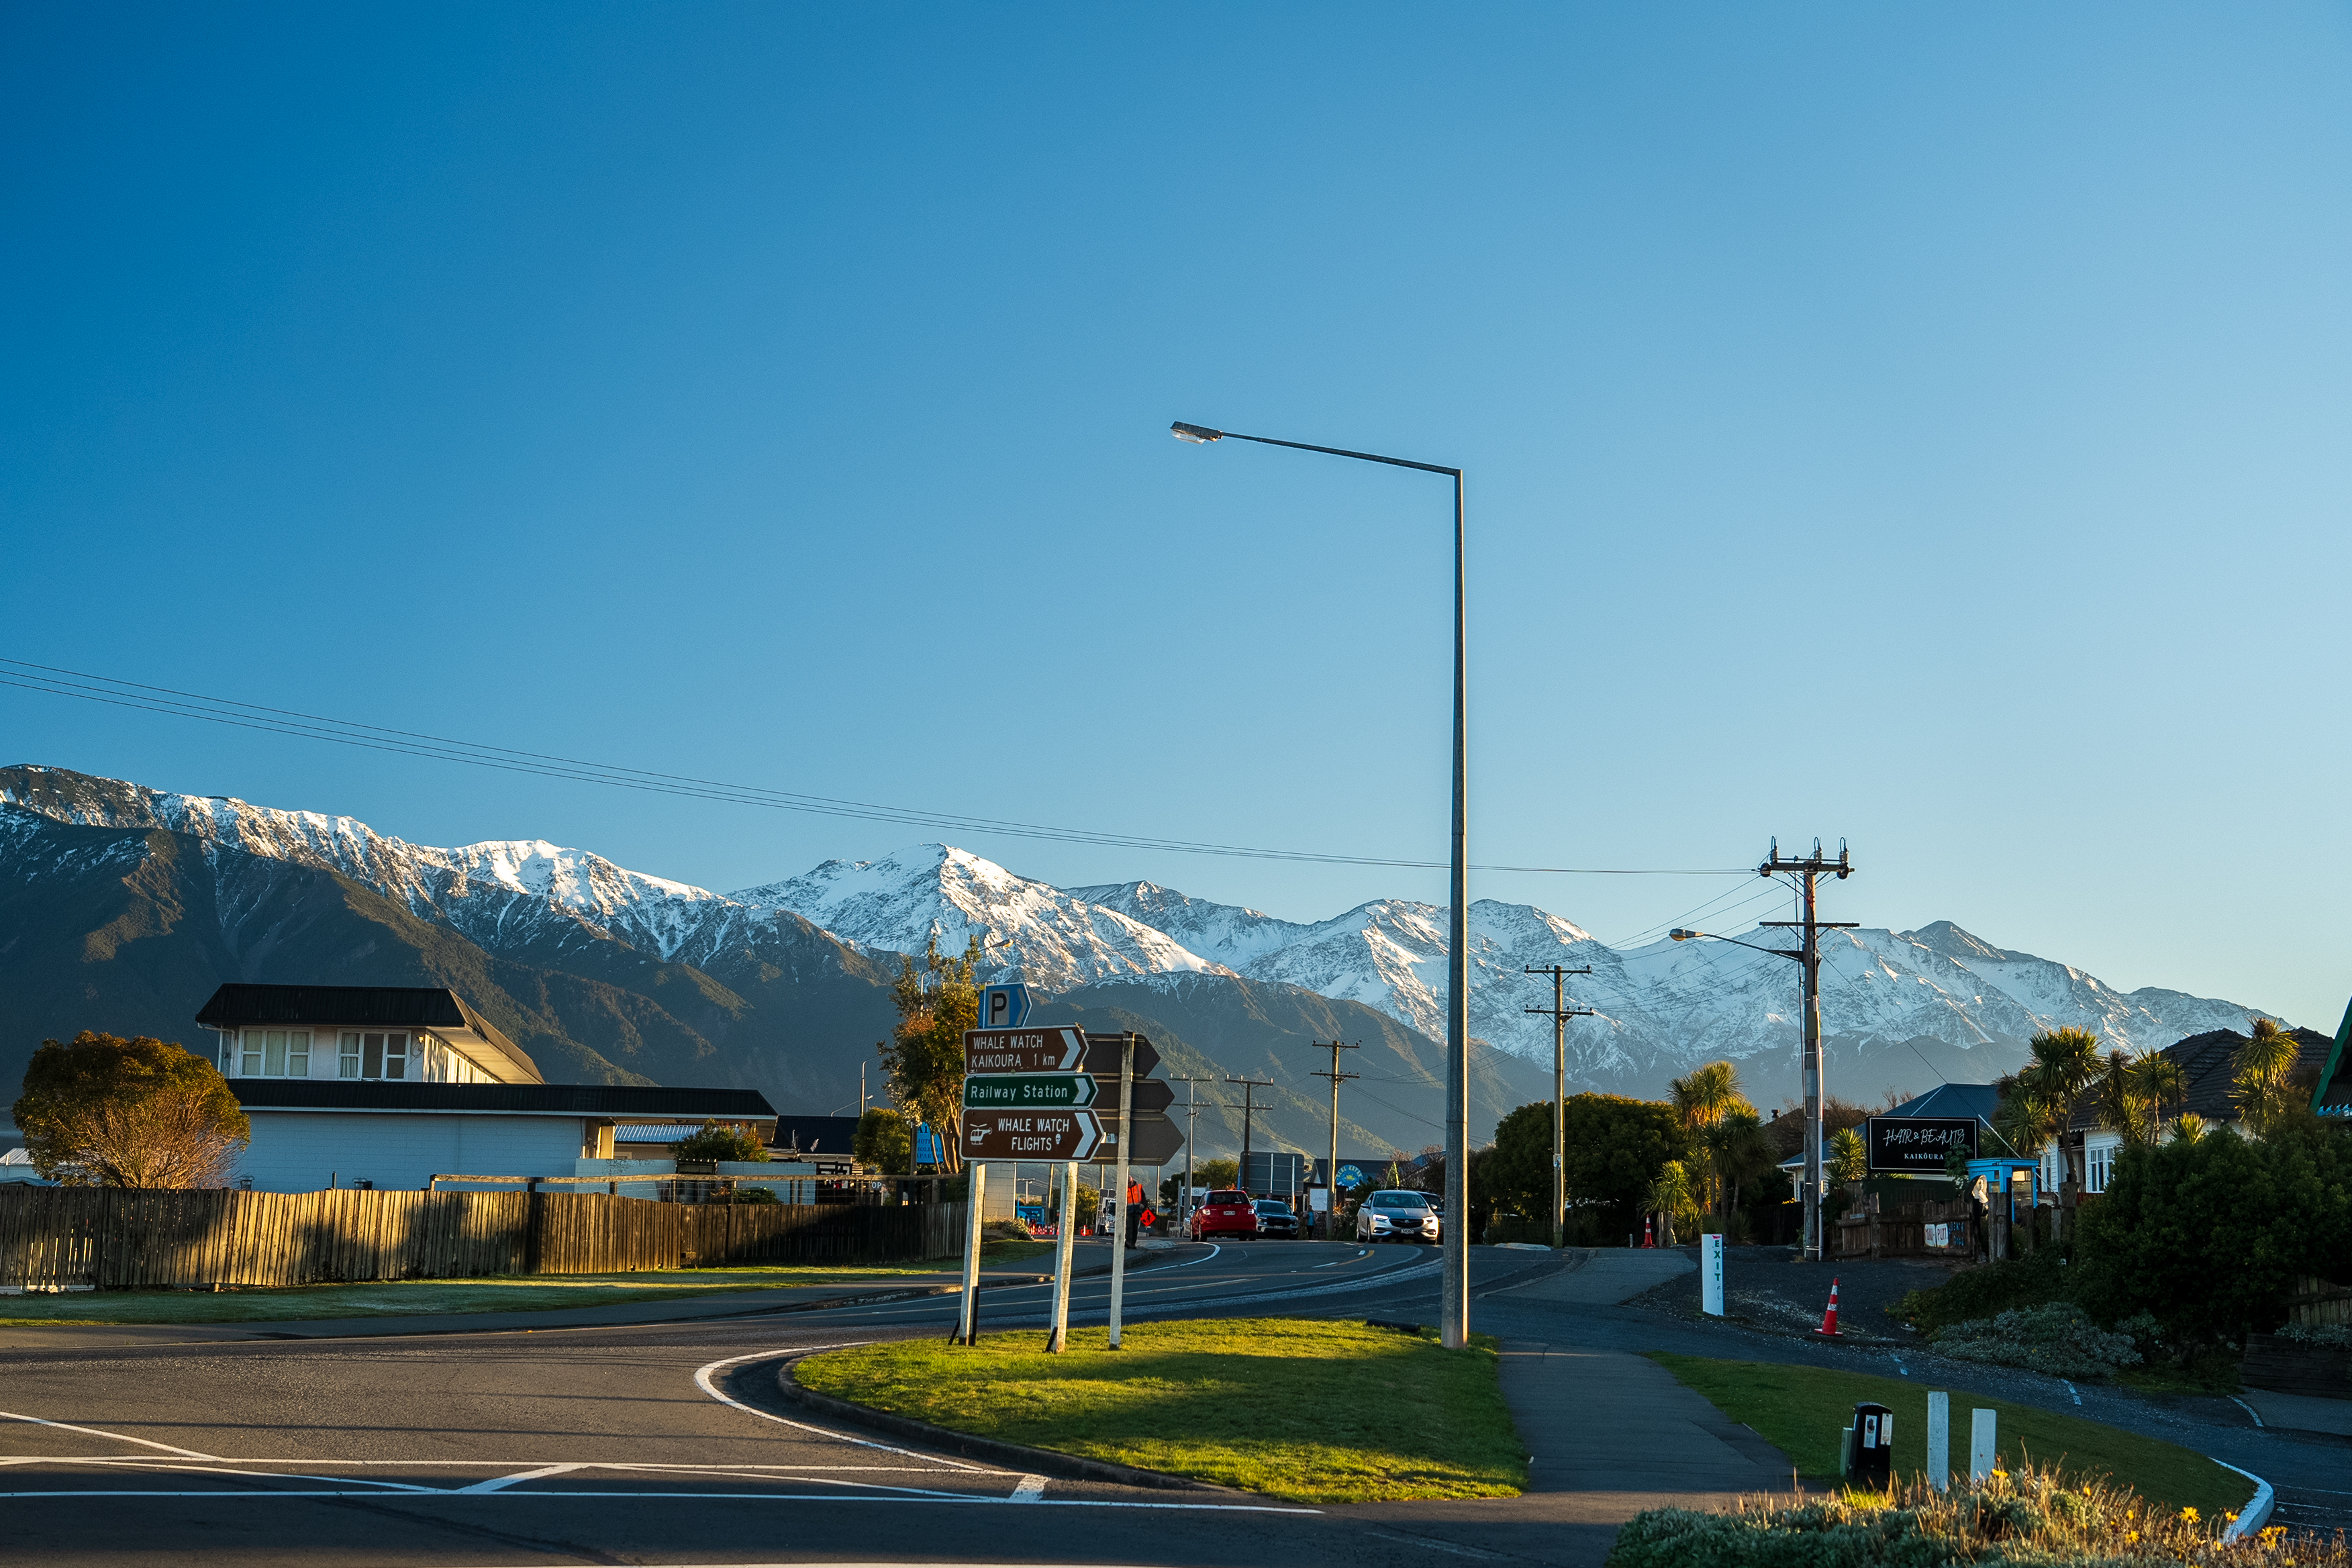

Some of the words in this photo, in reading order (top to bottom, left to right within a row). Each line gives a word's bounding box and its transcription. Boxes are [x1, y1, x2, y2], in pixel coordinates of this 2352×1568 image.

[991, 993, 1007, 1024] P
[973, 1036, 1005, 1049] WHALE
[1010, 1034, 1043, 1048] WATCH
[971, 1054, 1022, 1068] KAIKOURA
[1034, 1052, 1037, 1066] 1
[1042, 1053, 1055, 1066] km
[971, 1085, 1016, 1101] Railway
[1024, 1085, 1067, 1097] Station
[998, 1118, 1032, 1132] WHALE
[1037, 1118, 1069, 1132] WATCH
[1012, 1136, 1052, 1150] FLIGHTS
[1883, 1128, 1913, 1146] HAIR
[1912, 1132, 1920, 1140] &
[1920, 1128, 1965, 1145] BEAUTY
